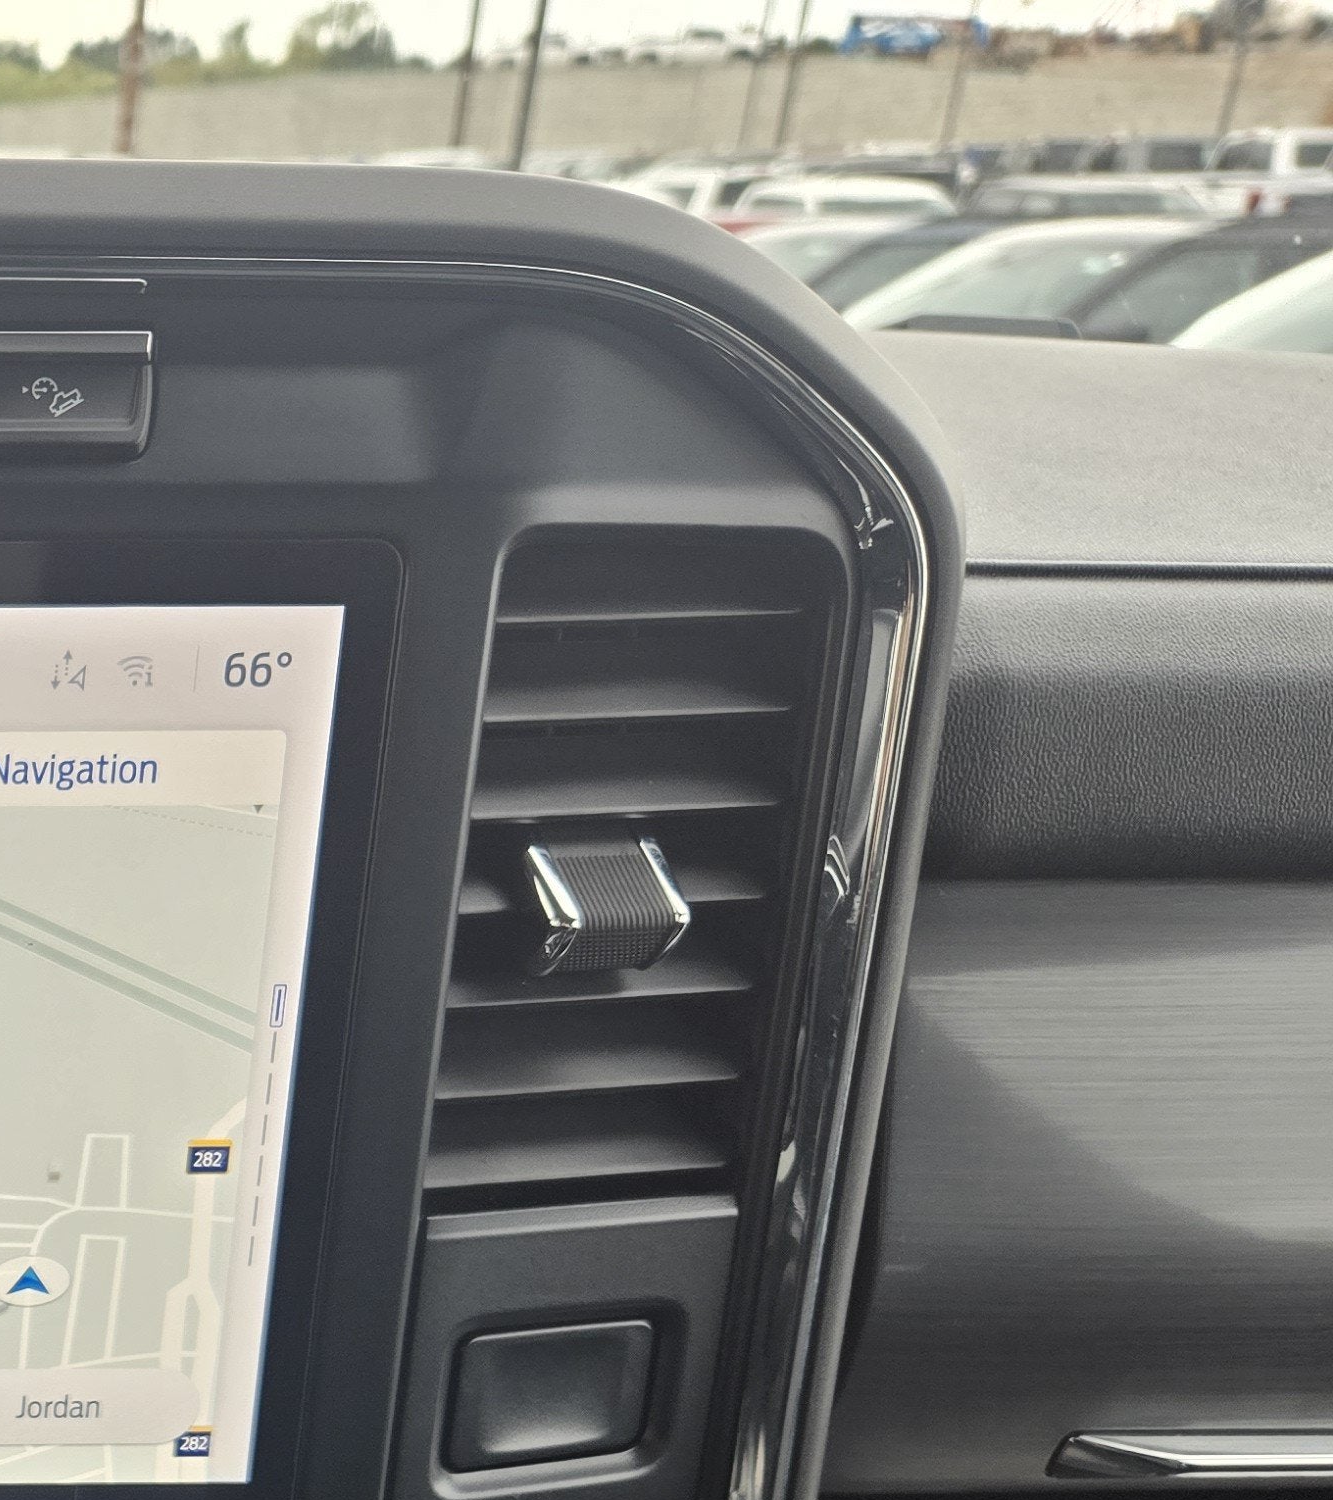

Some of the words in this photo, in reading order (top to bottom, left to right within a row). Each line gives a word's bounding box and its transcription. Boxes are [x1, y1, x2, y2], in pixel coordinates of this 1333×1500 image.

[223, 651, 293, 688] 66°
[193, 1150, 222, 1168] 282
[15, 1394, 100, 1420] Jordan
[179, 1434, 209, 1453] 282
